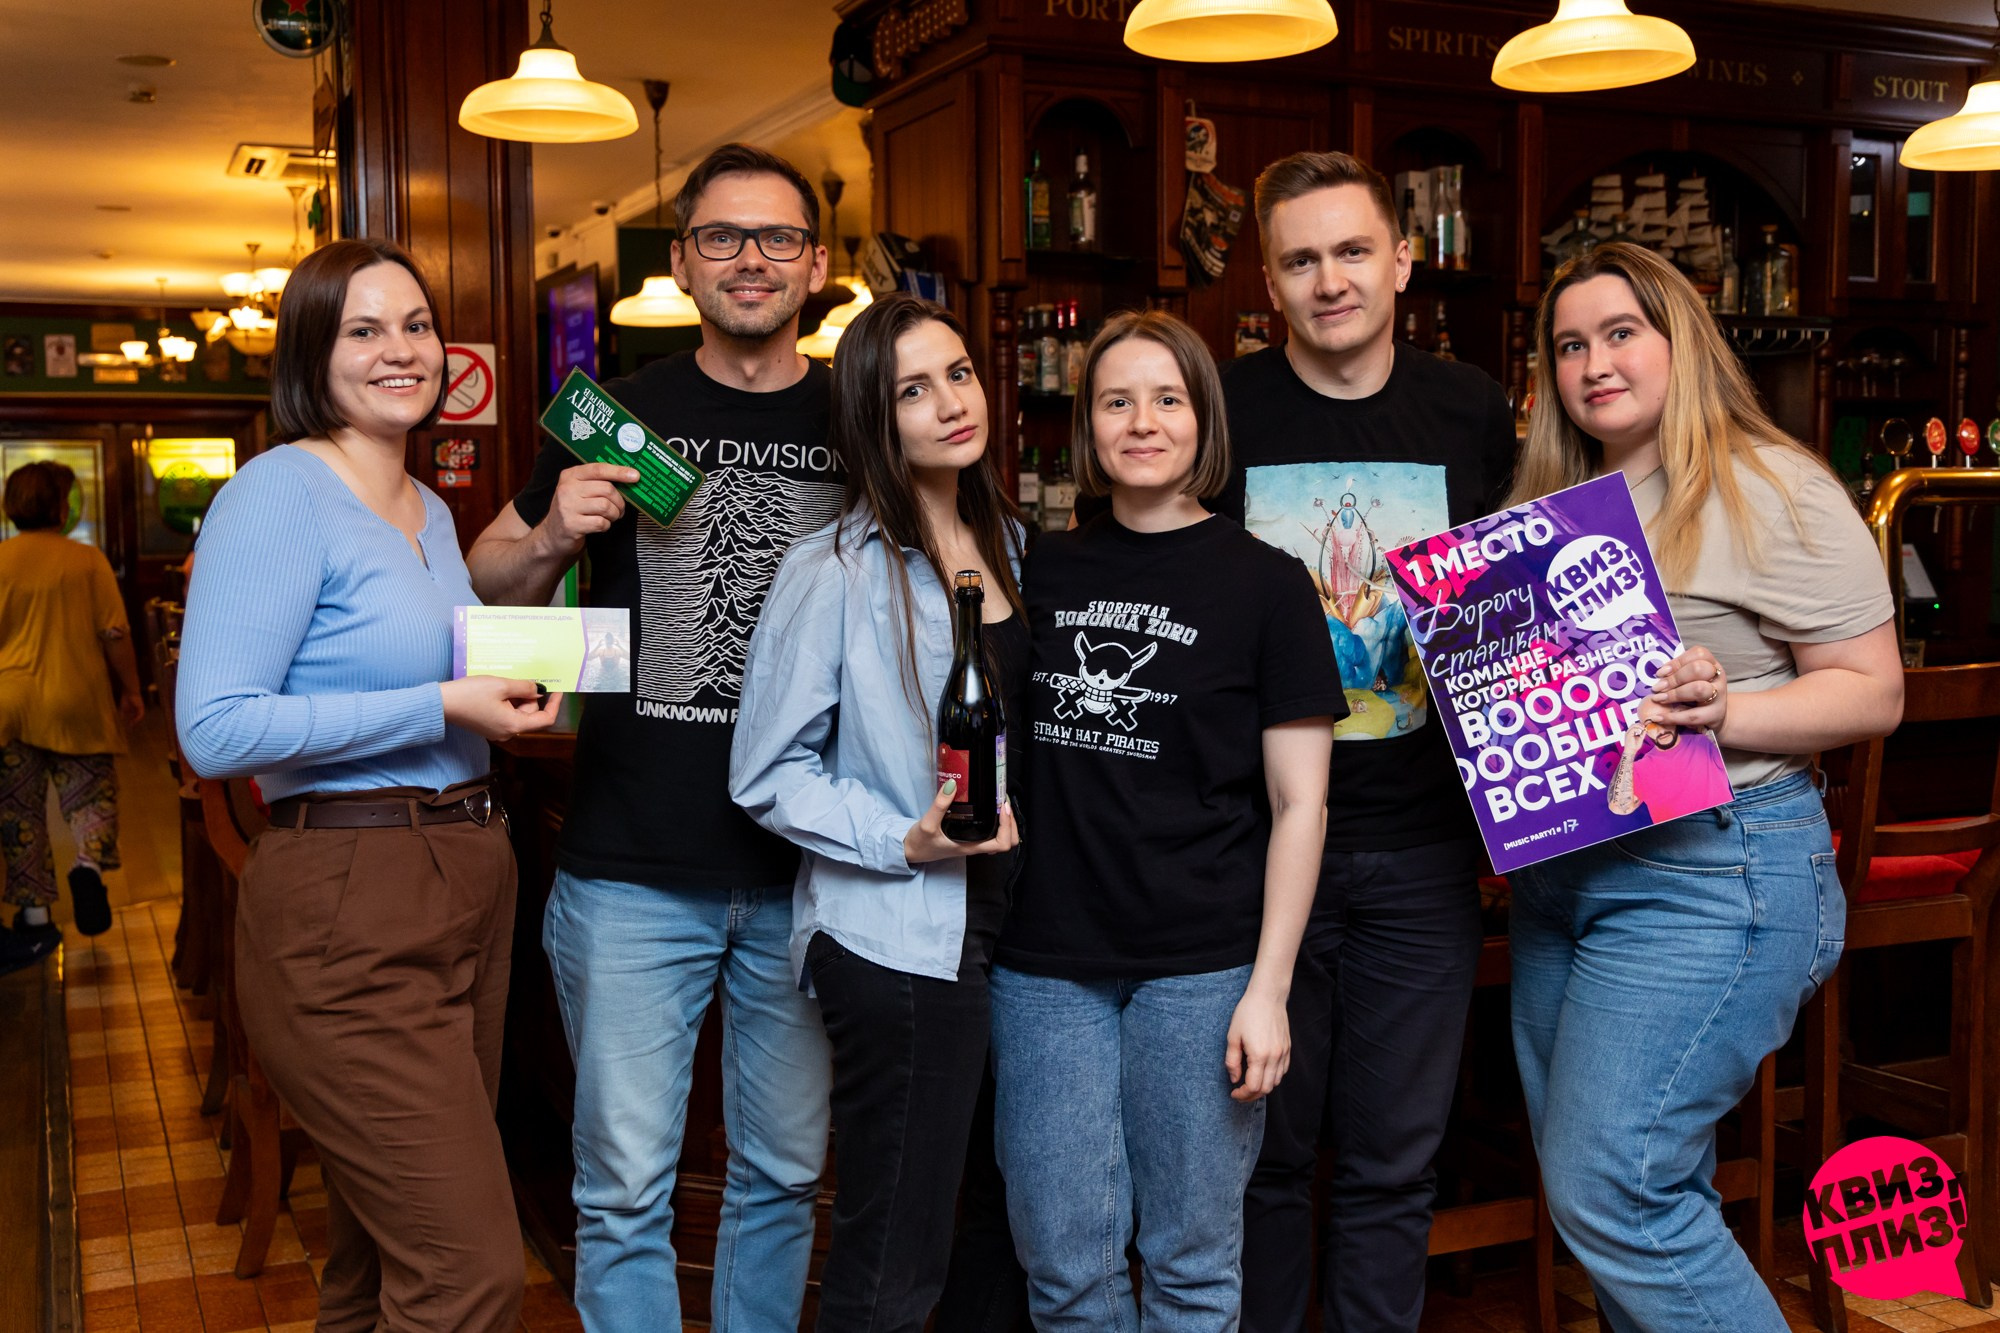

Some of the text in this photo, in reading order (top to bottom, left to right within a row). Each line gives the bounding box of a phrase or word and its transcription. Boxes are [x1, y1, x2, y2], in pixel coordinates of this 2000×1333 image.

[1388, 26, 1499, 60] SPIRITS
[1873, 76, 1950, 103] STOUT
[566, 390, 616, 436] TRINITY
[583, 387, 615, 416] IRISH PUB
[667, 437, 710, 463] OY
[1406, 518, 1554, 587] 1 МЕСТО
[1559, 558, 1646, 623] ПЛИЗ!
[1087, 601, 1170, 620] SWORDSMAN
[1412, 583, 1537, 643] Дорогу
[1145, 617, 1199, 646] ZORO
[1032, 671, 1050, 684] EST.
[1445, 646, 1553, 694] КОМАНДЕ,
[1451, 632, 1660, 713] КОТОРАЯ РАЗНЕСЛА
[636, 699, 727, 724] UNKNOWN
[1150, 692, 1178, 705] 1997
[1034, 721, 1160, 754] STRAW HAT PIRATES
[1484, 755, 1606, 823] ВСЕХ
